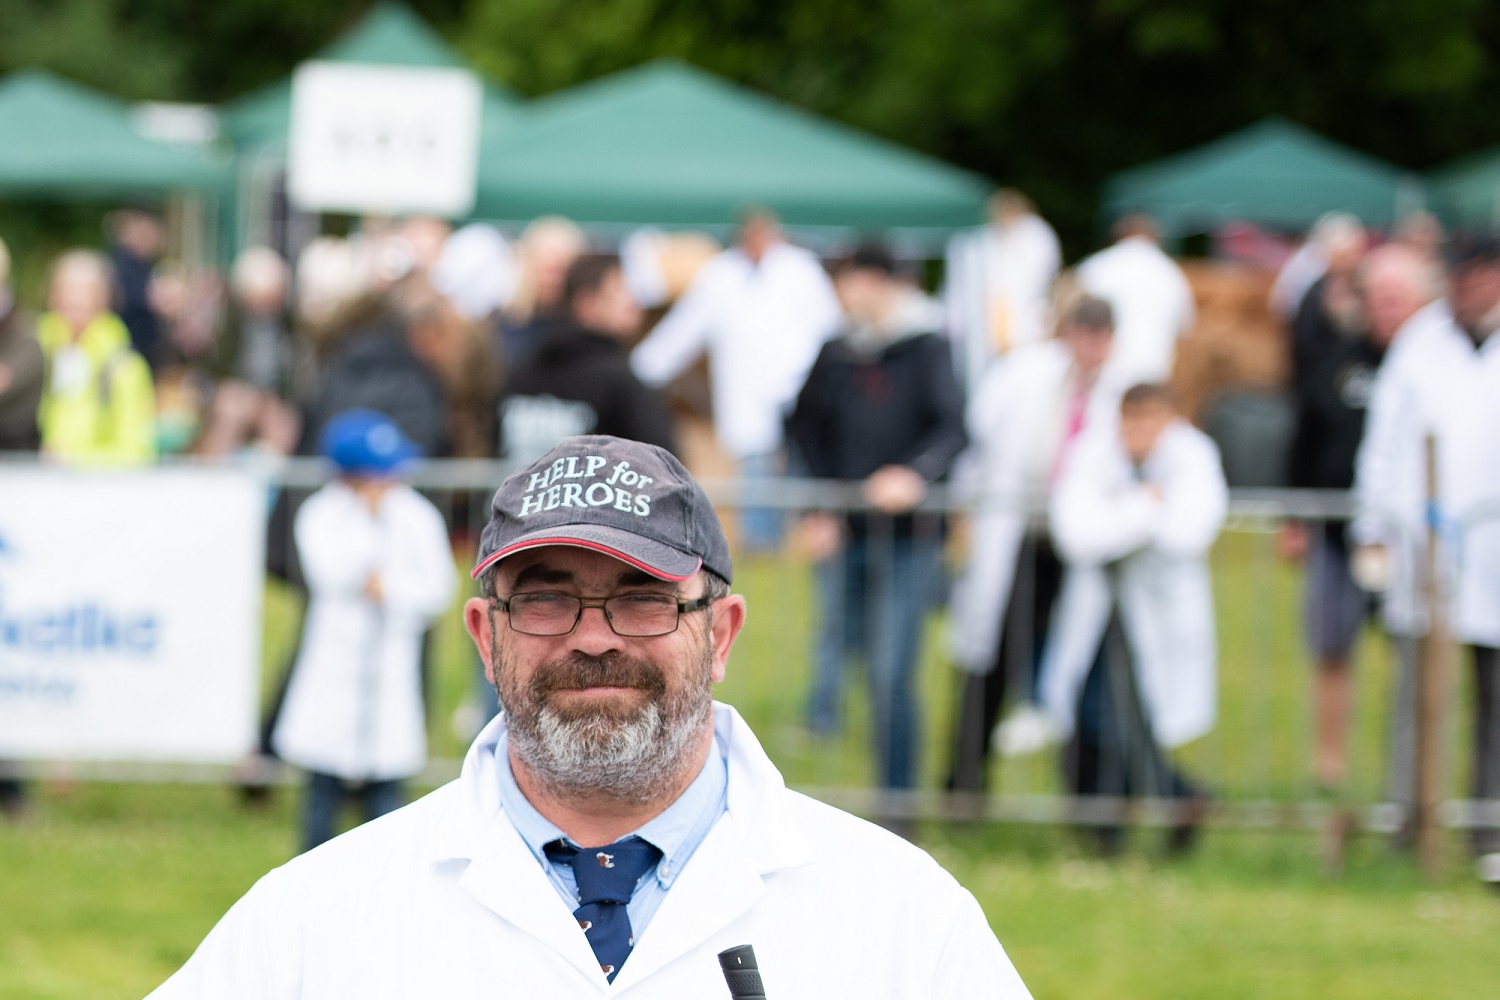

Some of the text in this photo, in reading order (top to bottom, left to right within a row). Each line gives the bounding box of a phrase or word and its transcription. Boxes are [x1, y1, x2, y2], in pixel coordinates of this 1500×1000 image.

[525, 455, 653, 493] HELP for
[518, 482, 651, 518] HEROES
